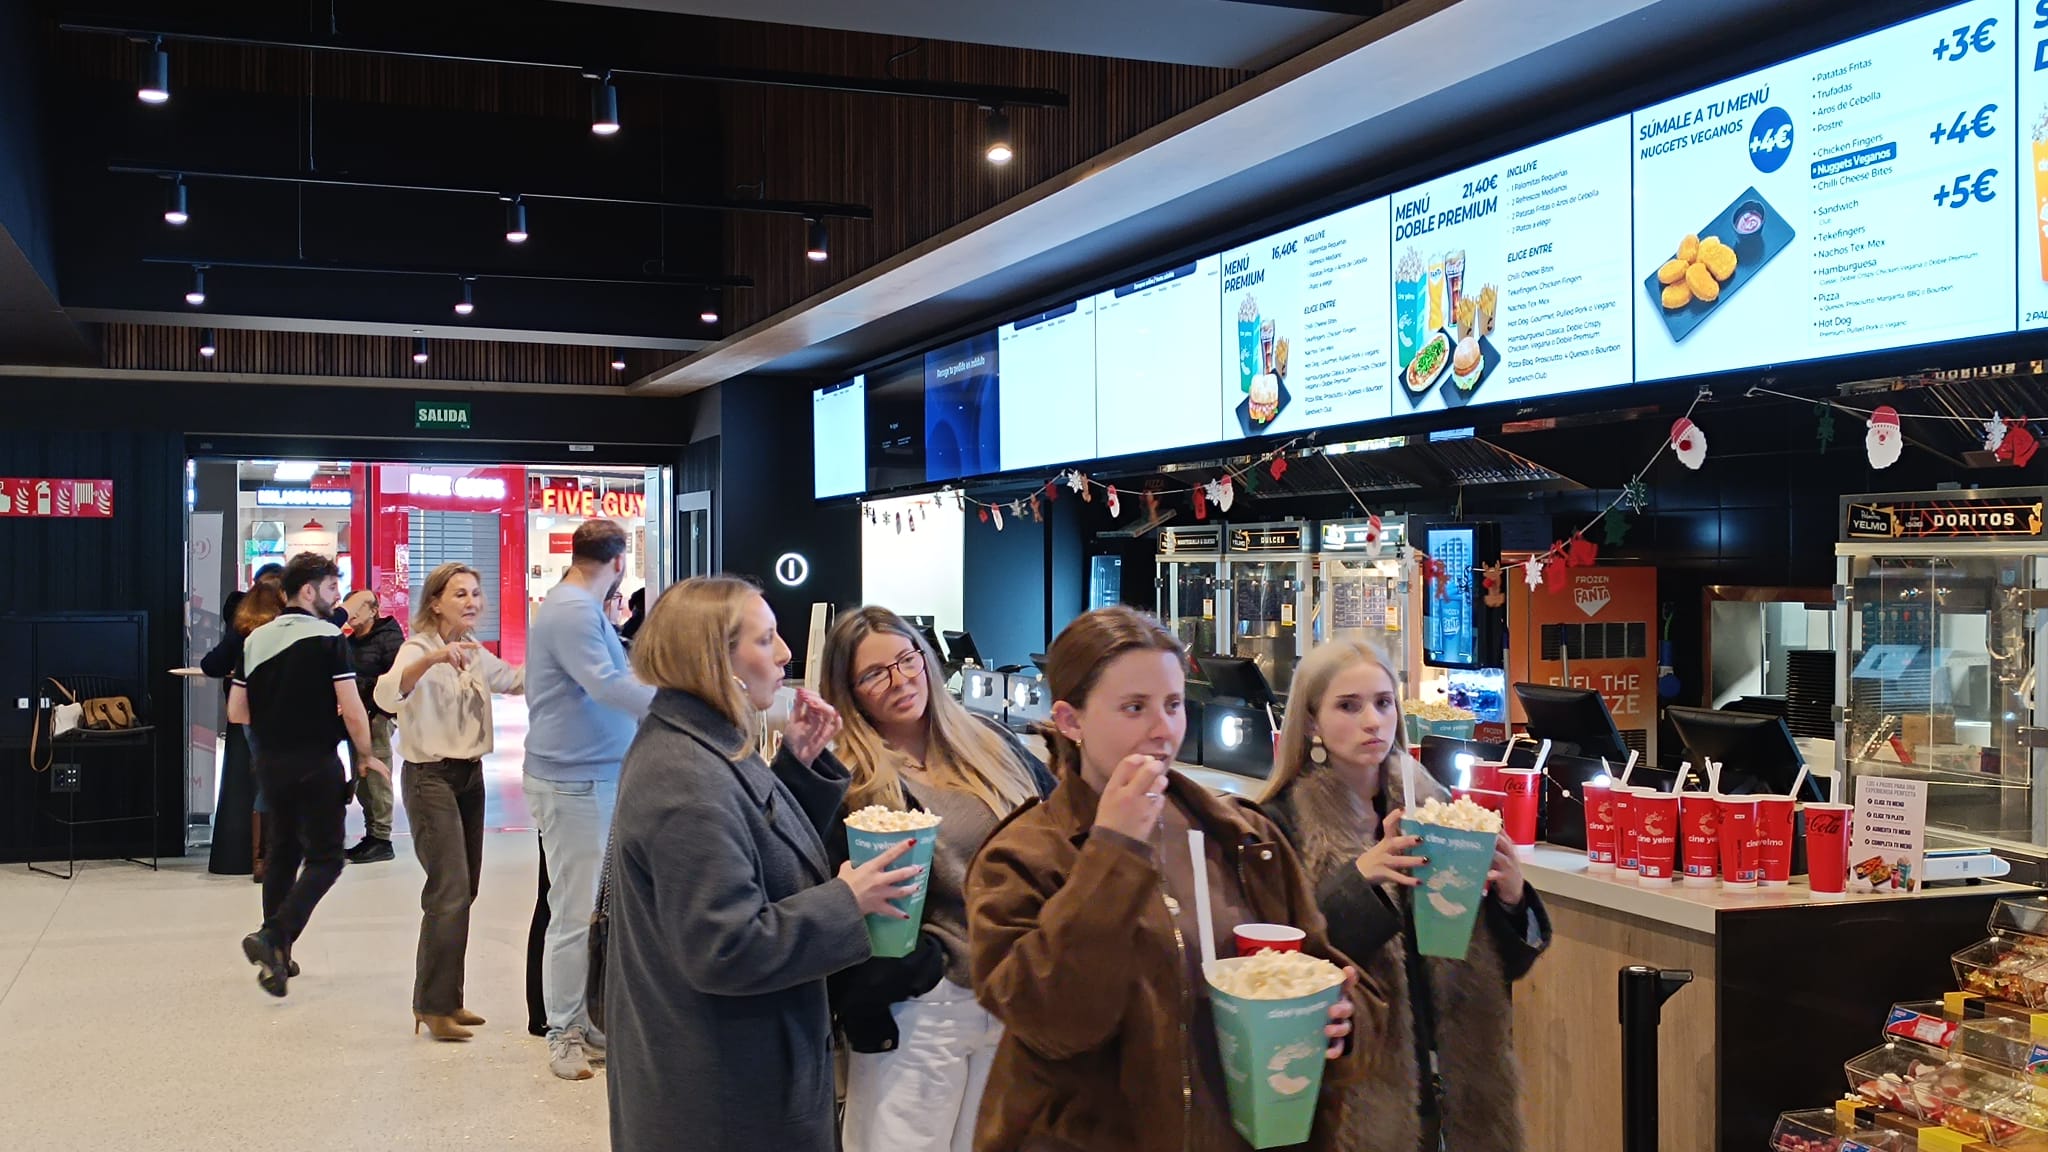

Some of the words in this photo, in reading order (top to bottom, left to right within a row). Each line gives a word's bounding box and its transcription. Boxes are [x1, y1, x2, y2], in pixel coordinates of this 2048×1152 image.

[1932, 17, 1998, 61] +3€
[1816, 67, 1848, 82] Patatas
[1848, 58, 1873, 73] Fritas
[1817, 82, 1853, 99] Trufadas
[1639, 109, 1692, 141] SÚMALE
[1693, 108, 1703, 124] A
[1706, 103, 1725, 120] TU
[1727, 83, 1770, 114] MENÚ
[1817, 104, 1836, 116] Aros
[1837, 100, 1848, 111] de
[1849, 91, 1881, 107] Cebolla
[1817, 119, 1843, 132] Postre
[1930, 103, 1998, 145] +4€
[1640, 135, 1688, 160] NUGGETS
[1690, 119, 1744, 145] VEGANOS
[1750, 123, 1793, 153] +4€
[1817, 142, 1851, 157] Chicken
[1852, 132, 1884, 148] Fingers
[1507, 160, 1538, 179] INCLUYE
[1816, 157, 1852, 176] Nuggets
[1853, 148, 1892, 167] Veganos
[1462, 174, 1498, 200] 21,40€
[1515, 176, 1541, 191] Palomitas
[1541, 168, 1568, 184] Pequeñas
[1817, 178, 1838, 190] Chilli
[1839, 173, 1869, 186] Cheese
[1871, 165, 1893, 179] Bites
[1515, 191, 1541, 204] Refrescos
[1541, 184, 1568, 198] Medianos
[1933, 168, 1999, 209] +5€
[1395, 192, 1431, 222] MENÚ
[1515, 206, 1536, 219] Patatas
[1536, 203, 1551, 215] Fritas
[1556, 198, 1569, 208] Aros
[1577, 189, 1600, 202] Cebolla
[1817, 199, 1859, 216] Sandwich
[1395, 214, 1436, 242] DOBLE
[1437, 195, 1498, 230] PREMIUM
[1303, 229, 1326, 244] INCLUYE
[1818, 225, 1866, 242] Tekefingers
[1271, 240, 1298, 260] 16,40€
[1507, 250, 1527, 263] ELIGE
[1529, 242, 1553, 259] ENTRE
[1818, 244, 1849, 259] Nachos
[1850, 242, 1865, 253] Tex
[1867, 239, 1885, 249] Mex
[1224, 252, 1250, 277] MENÚ
[1521, 268, 1540, 279] Cheese
[1541, 264, 1554, 275] Bites
[1818, 257, 1877, 276] Hamburguesa
[1224, 268, 1265, 294] PREMIUM
[1539, 279, 1561, 290] Chicken
[1561, 274, 1583, 288] Fingers
[1303, 303, 1319, 315] ELIGE
[1319, 299, 1337, 312] ENTRE
[1507, 303, 1527, 313] Nachos
[1527, 301, 1537, 309] Tex
[1538, 298, 1550, 306] Mex
[1818, 291, 1840, 303] Pizza
[1507, 319, 1517, 327] Hot
[1556, 308, 1574, 318] Pulled
[1574, 305, 1588, 316] Pork
[1593, 300, 1616, 312] Vegano
[1818, 317, 1834, 329] Hot
[1834, 315, 1852, 328] Dog
[2025, 311, 2032, 322] 2
[1507, 330, 1545, 343] Hamburguesa
[1566, 322, 1583, 333] Doble
[1556, 335, 1572, 346] Doble
[1573, 330, 1601, 343] Premium
[1507, 358, 1522, 368] Pizza
[1595, 343, 1621, 355] Bourbon
[1507, 373, 1534, 385] Sandwich
[1534, 371, 1548, 381] Club
[418, 408, 467, 423] SALIDA
[542, 488, 597, 517] FIVE
[1853, 519, 1888, 531] YELMO
[1933, 512, 2015, 527] DORITOS
[1260, 535, 1285, 545] DULCES
[1575, 575, 1610, 584] FROZEN
[1574, 585, 1611, 604] FANTA
[1601, 674, 1640, 691] THE
[1589, 821, 1605, 830] cine
[1810, 813, 1842, 835] Cola
[854, 838, 873, 849] cine
[1688, 835, 1705, 843] cine
